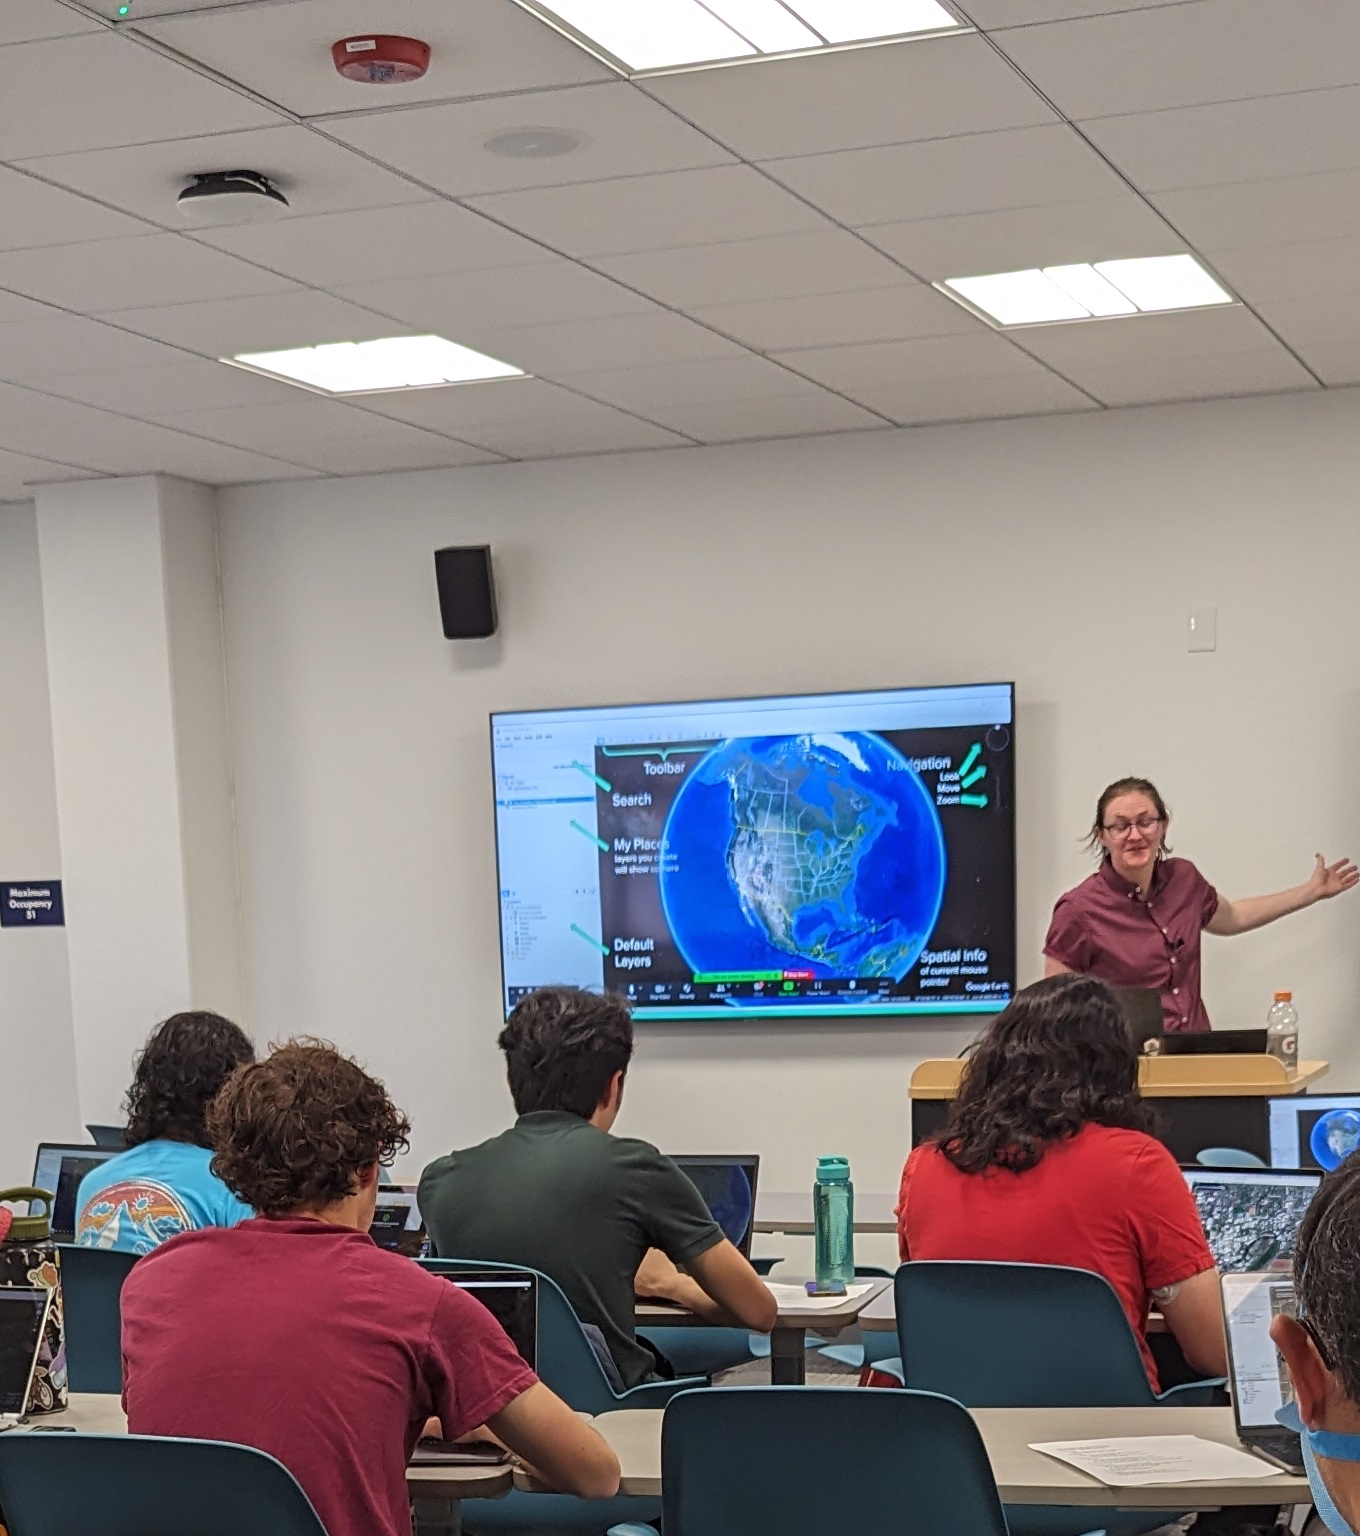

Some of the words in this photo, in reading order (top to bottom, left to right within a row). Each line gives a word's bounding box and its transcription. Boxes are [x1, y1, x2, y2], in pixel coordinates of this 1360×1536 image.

[643, 761, 686, 776] Toolbar
[887, 757, 951, 773] Navigation
[940, 772, 960, 781] Look
[937, 783, 960, 793] Move
[612, 792, 652, 807] Search
[936, 796, 960, 805] Zoom
[614, 839, 631, 853] My
[633, 838, 670, 851] Places
[638, 855, 653, 864] you
[654, 853, 678, 863] cate
[629, 865, 649, 875] show
[9, 899, 53, 910] Occupancy
[614, 938, 654, 952] Default
[614, 955, 651, 970] Layers
[920, 949, 961, 965] Spatial
[920, 967, 929, 976] of
[930, 966, 960, 975] current
[960, 966, 989, 975] mouse
[920, 978, 950, 989] pointer
[965, 981, 991, 992] Google
[991, 981, 1010, 990] Earth
